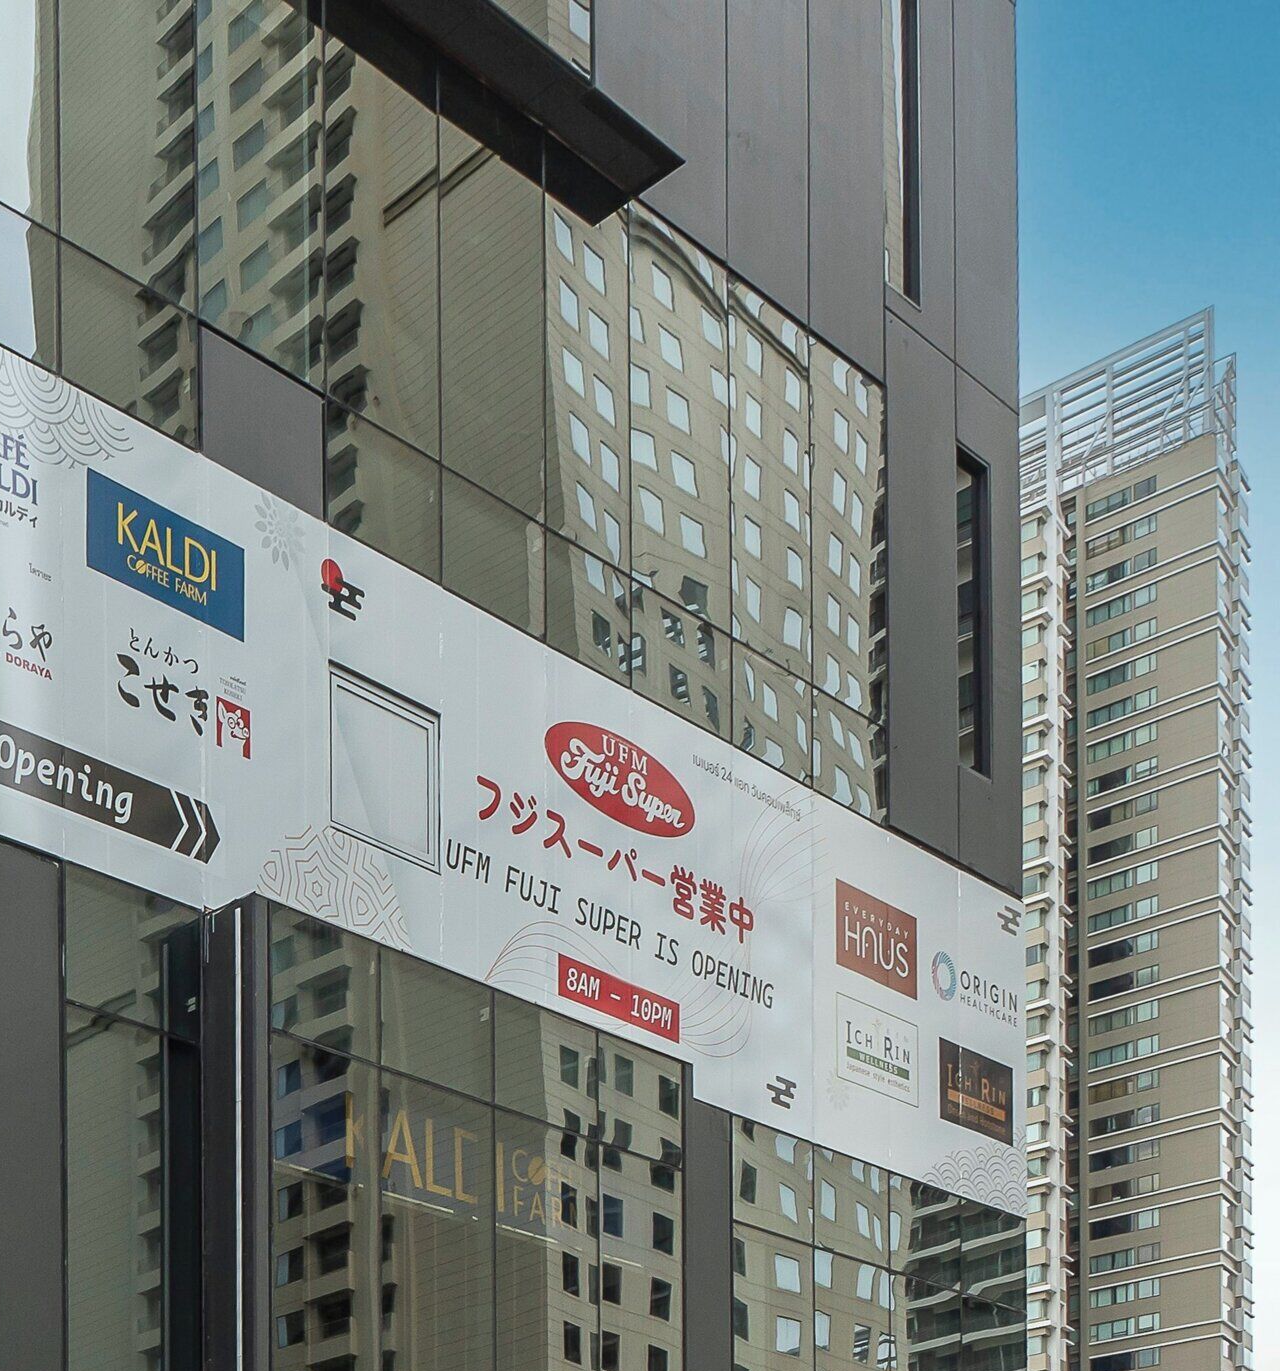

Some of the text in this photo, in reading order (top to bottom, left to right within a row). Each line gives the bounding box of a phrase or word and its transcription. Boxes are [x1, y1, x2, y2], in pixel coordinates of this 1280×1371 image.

[117, 502, 217, 591] KALDI
[126, 554, 207, 606] COFFEE FARM
[5, 652, 53, 680] DORAYA
[129, 628, 199, 674] とんかつ
[116, 653, 210, 737] こせき
[602, 734, 648, 774] UFM
[721, 767, 733, 783] 24
[560, 738, 686, 829] Fuji Super
[476, 775, 755, 944] フジスーパー営業中
[445, 839, 775, 1009] UFM FUJI SUPER IS OPENING
[844, 901, 910, 939] EVERYDAY
[844, 915, 909, 978] HAUS
[566, 967, 601, 1001] 8AM
[631, 994, 673, 1030] 10PM
[959, 994, 1018, 1028] HEALTHCARE
[960, 970, 1018, 1013] ORIGIN
[858, 1052, 899, 1076] WELLNESS
